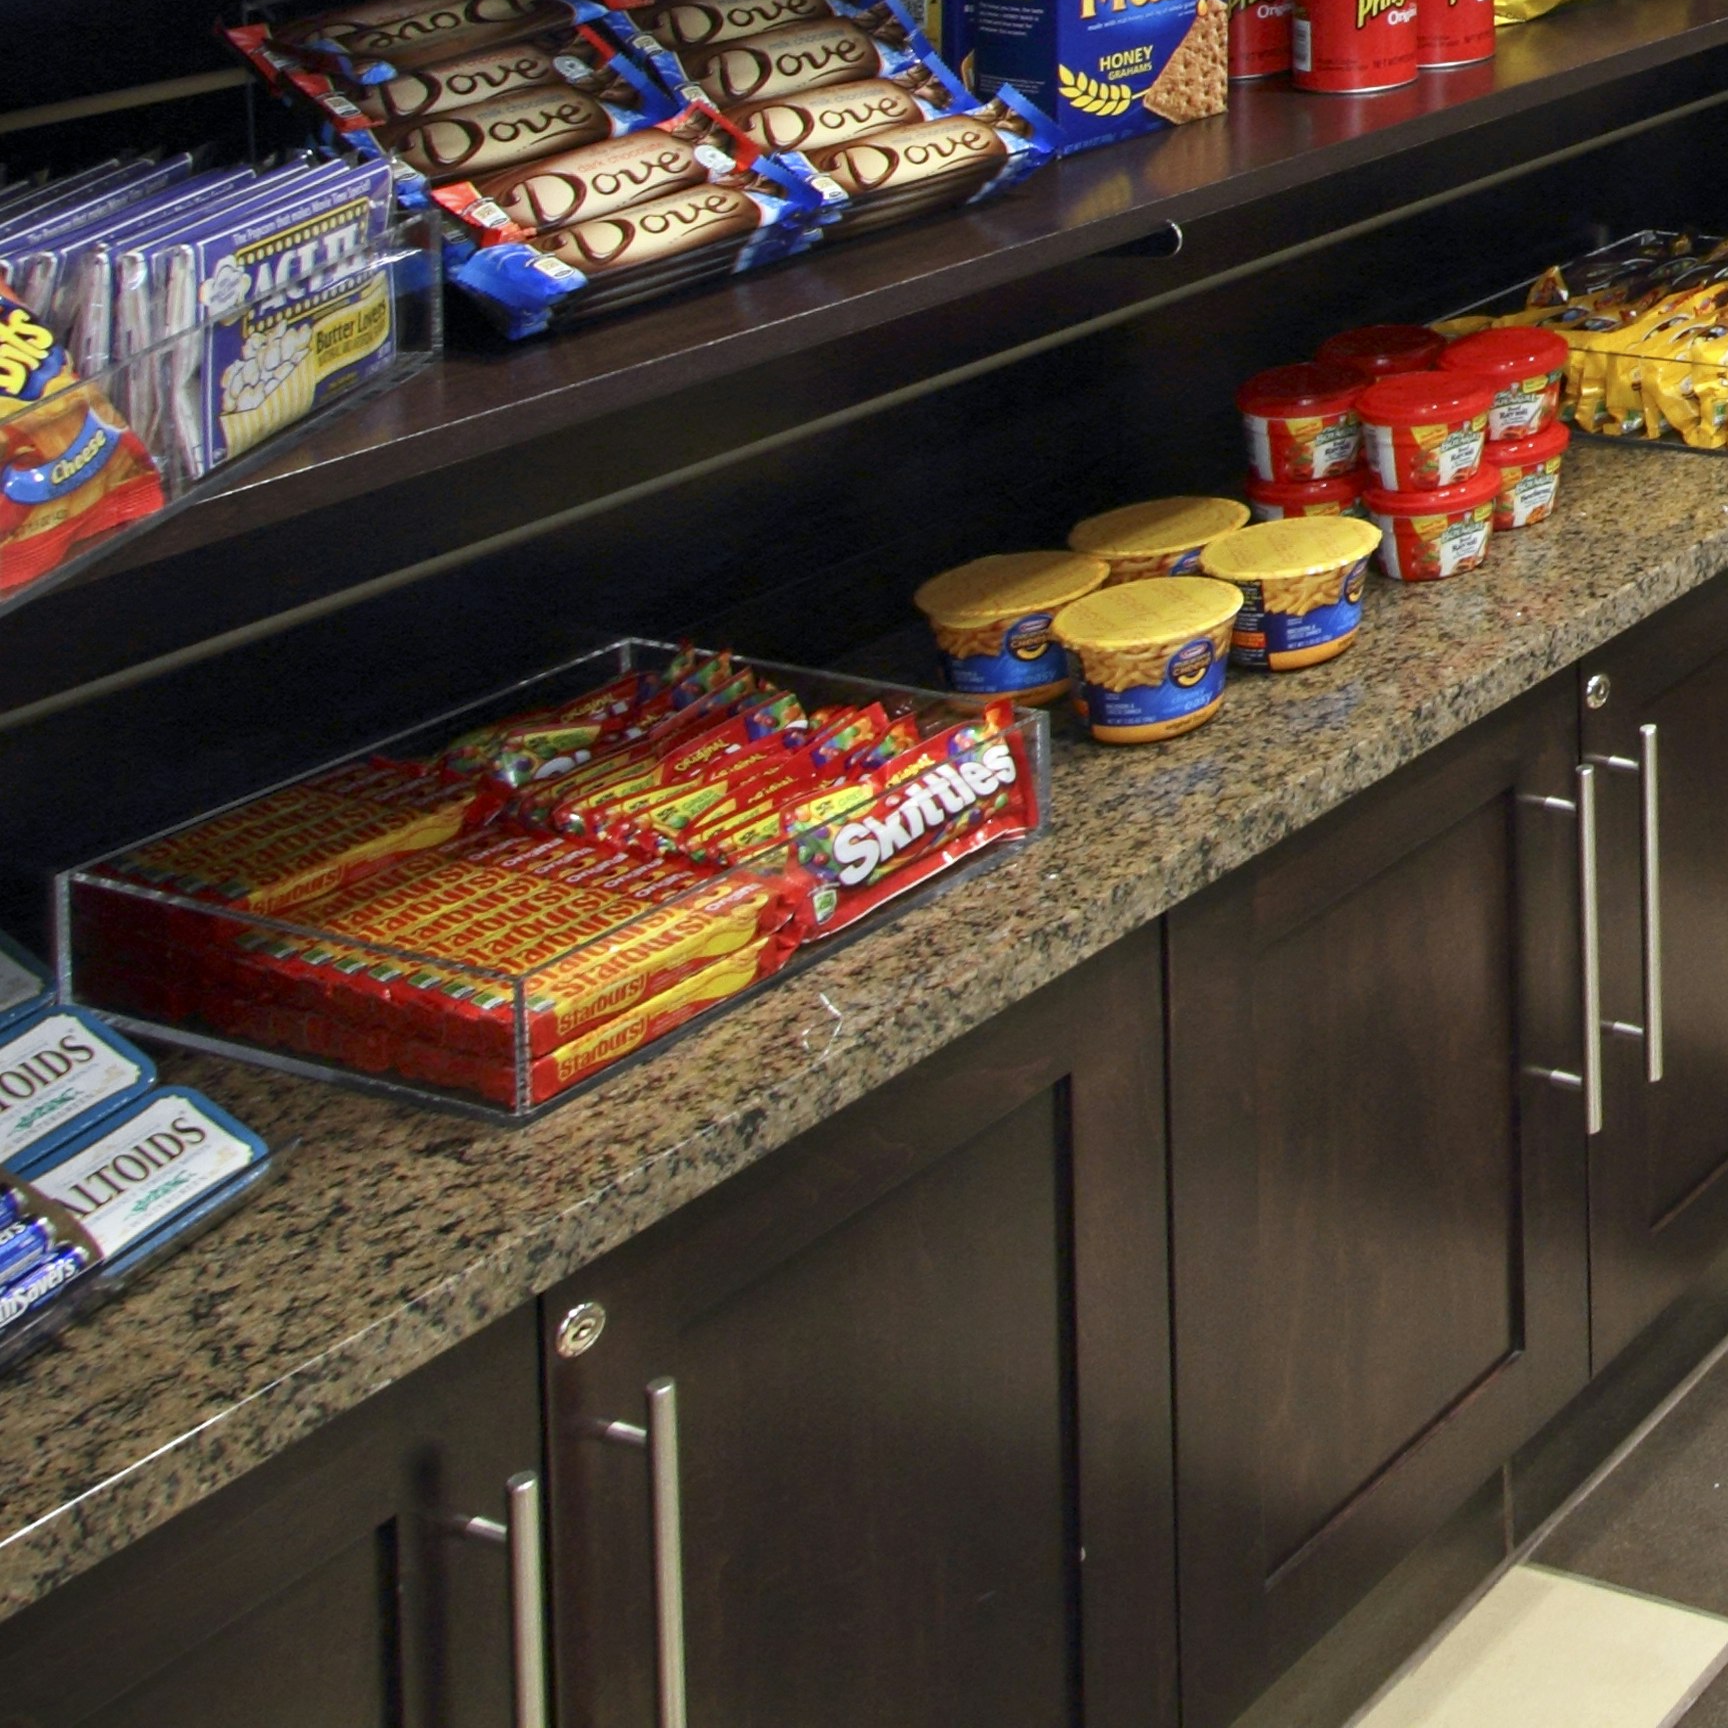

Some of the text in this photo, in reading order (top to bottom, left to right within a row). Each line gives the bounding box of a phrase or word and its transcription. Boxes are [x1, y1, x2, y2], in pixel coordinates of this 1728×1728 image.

[697, 38, 866, 102] Dove
[1100, 44, 1154, 72] HONEY
[1108, 63, 1153, 81] GRAHAMS
[401, 101, 593, 170] Dove
[739, 96, 909, 152] Dove
[500, 151, 692, 230] Dove
[821, 129, 991, 190] Dove
[542, 193, 740, 265] Dove
[254, 239, 325, 317] ACT
[315, 318, 356, 354] Butter
[51, 429, 107, 484] Cheese
[833, 744, 1016, 886] Skittles
[559, 974, 646, 1032] Starburst
[0, 1034, 95, 1112] TOIDS
[559, 1016, 647, 1078] Starburst
